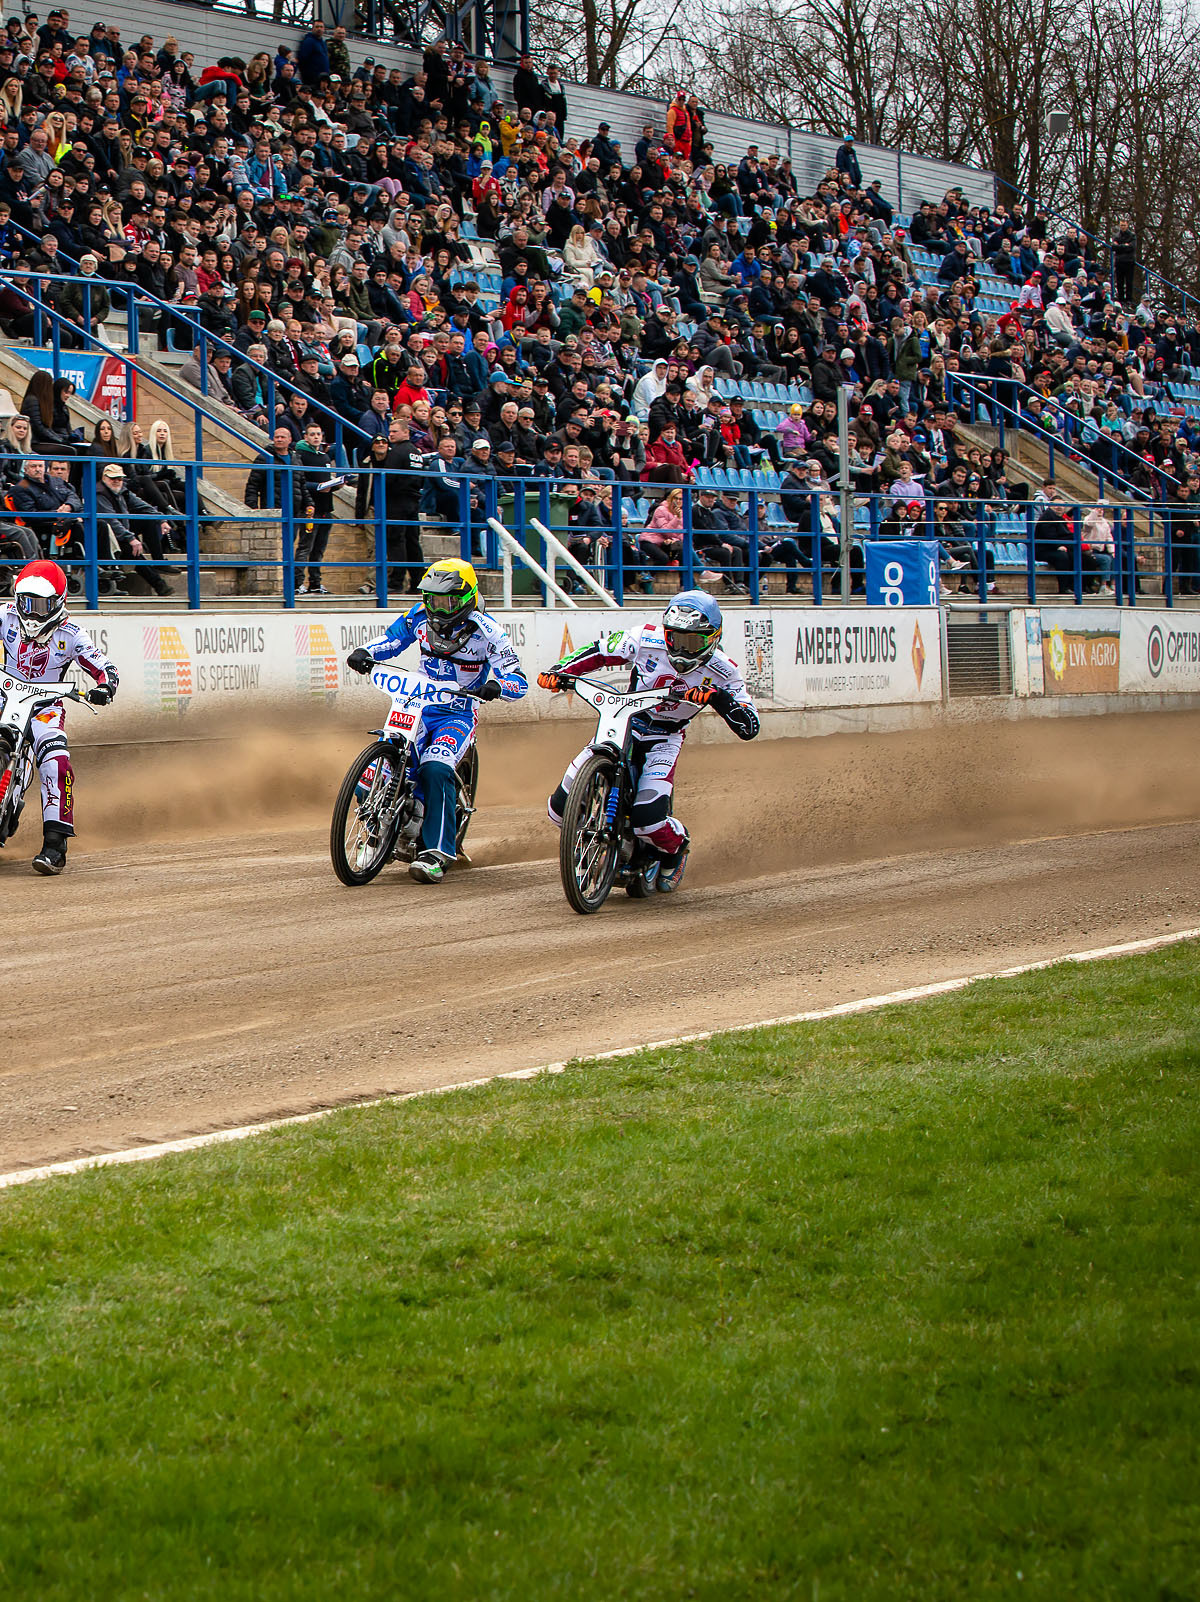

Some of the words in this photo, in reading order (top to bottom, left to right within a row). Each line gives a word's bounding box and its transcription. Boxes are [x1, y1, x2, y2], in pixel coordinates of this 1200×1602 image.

[195, 627, 265, 654] DAUGAVPILS
[341, 625, 390, 650] DAUGAVP
[795, 627, 841, 665] AMBER
[845, 626, 896, 663] STUDIOS
[1069, 643, 1087, 667] LVK
[1090, 643, 1116, 666] AGRO
[196, 666, 206, 691] IS
[210, 664, 260, 690] SPEEDWAY
[373, 672, 455, 702] STOLARO
[806, 675, 890, 692] WWW.AMBER-STUDIOS.COM
[16, 683, 49, 698] OPTIBET
[607, 696, 644, 708] OPTIBET
[391, 713, 414, 724] AMD
